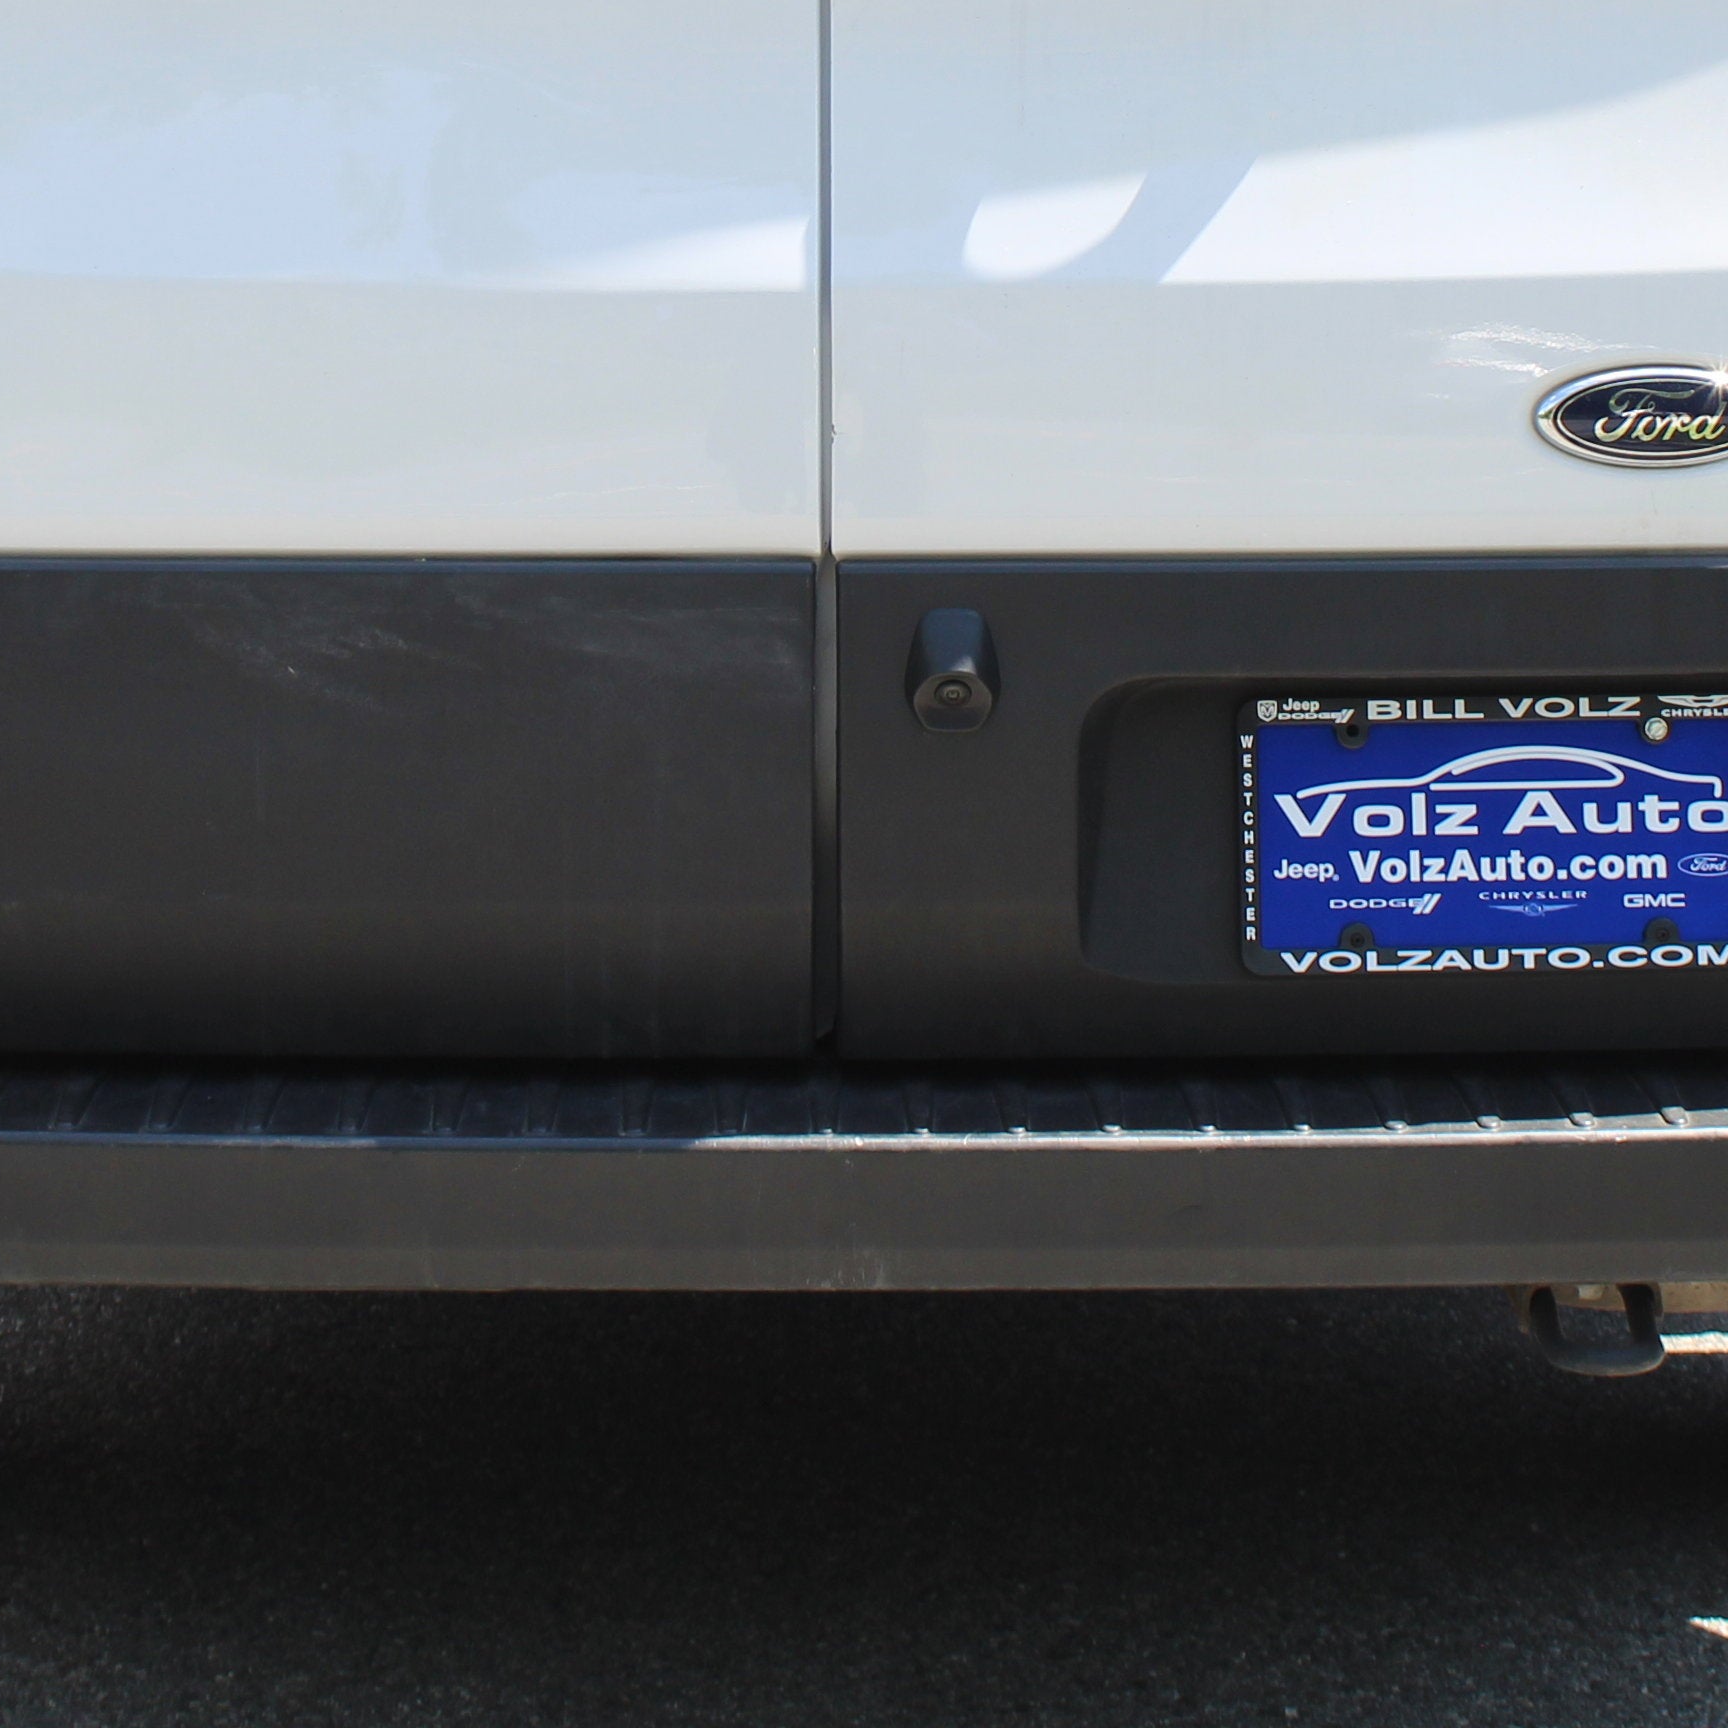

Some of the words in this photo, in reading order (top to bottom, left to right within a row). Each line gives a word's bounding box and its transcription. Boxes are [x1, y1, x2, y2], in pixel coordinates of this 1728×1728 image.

[1594, 388, 1728, 443] Ford
[1282, 698, 1321, 712] Jeep
[1368, 699, 1484, 721] BILL
[1499, 696, 1641, 719] VOLZ
[1278, 712, 1341, 720] DODGE
[1274, 792, 1479, 838] Volz
[1240, 735, 1256, 941] WESTCHESTER
[1349, 848, 1668, 883] VolzAuto.com
[1329, 898, 1422, 910] DODGE
[1478, 890, 1588, 900] CHRYSLER
[1623, 892, 1686, 909] GMC
